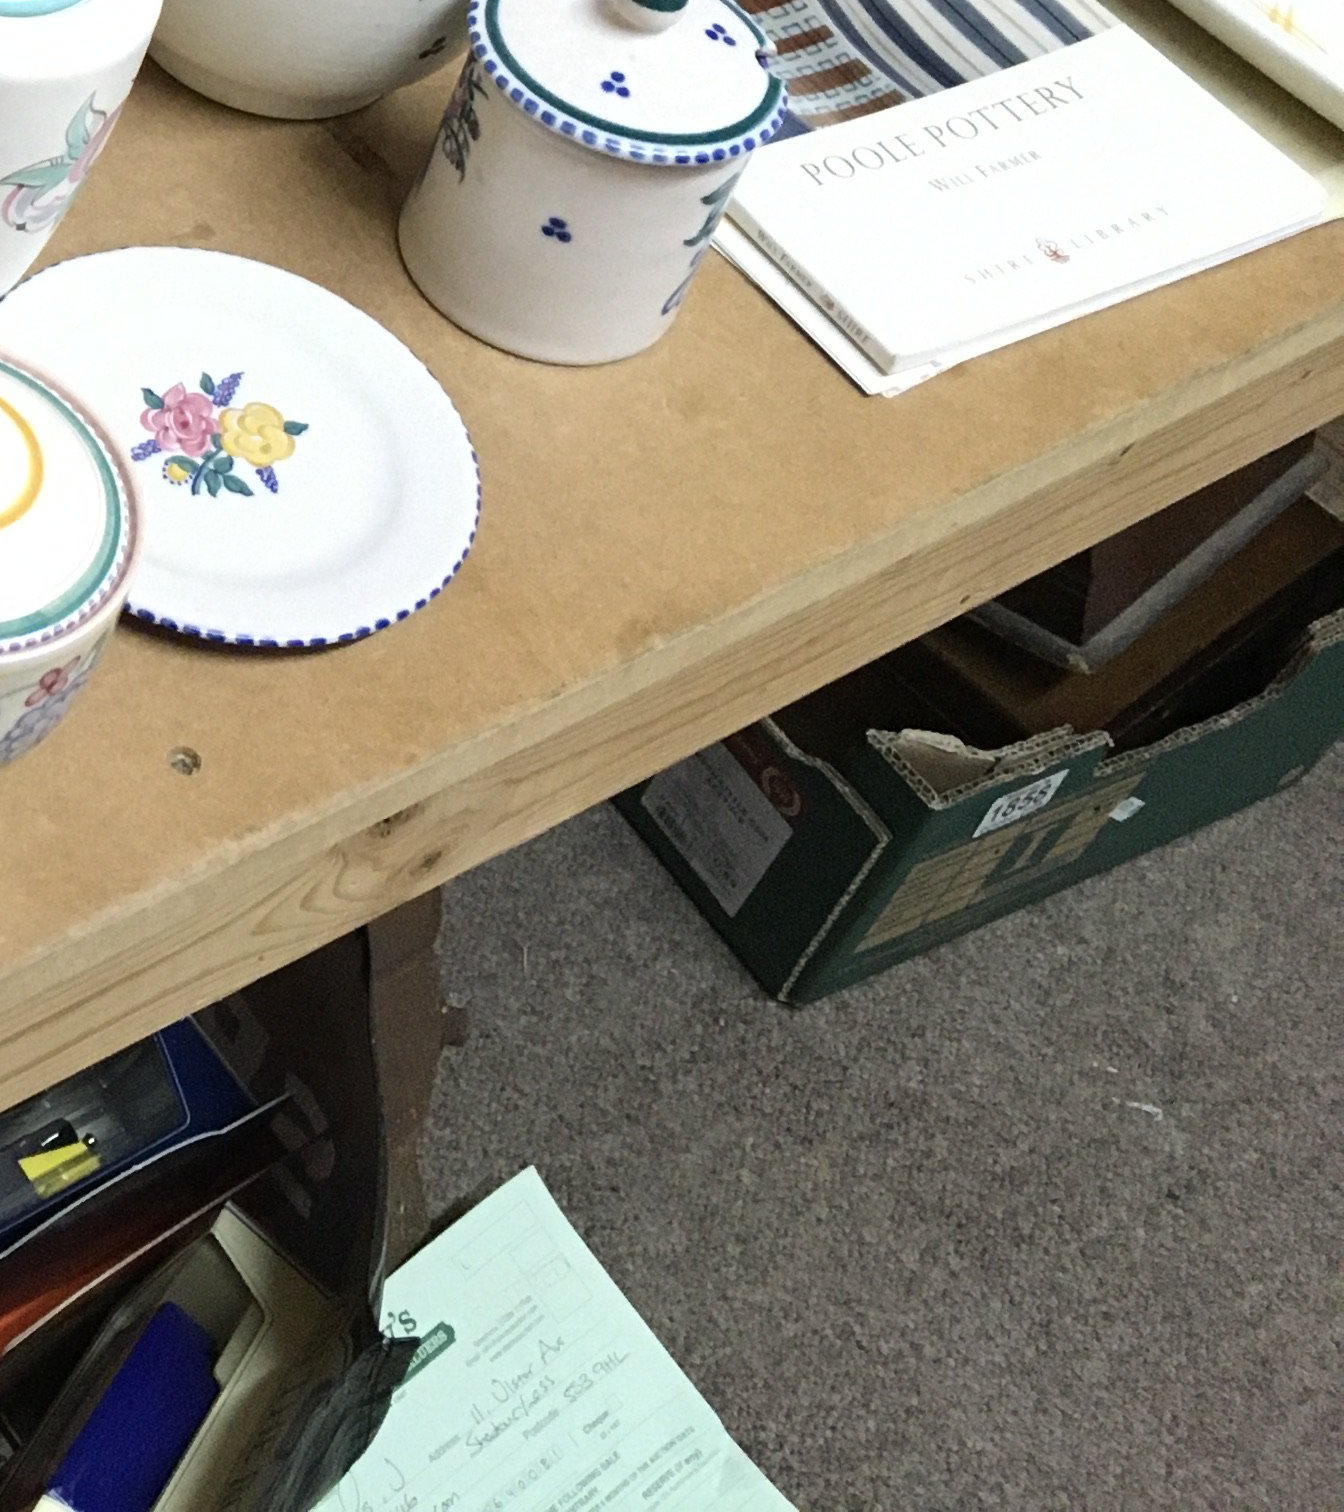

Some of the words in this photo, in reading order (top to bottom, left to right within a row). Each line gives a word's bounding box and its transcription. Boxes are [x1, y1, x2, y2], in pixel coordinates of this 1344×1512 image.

[800, 133, 926, 186] POOLE
[923, 75, 1085, 148] POTTERY
[927, 172, 973, 192] WILL
[974, 149, 1043, 178] FARMER
[963, 254, 1035, 285] SHIRE
[1069, 203, 1170, 249] LIBRARY
